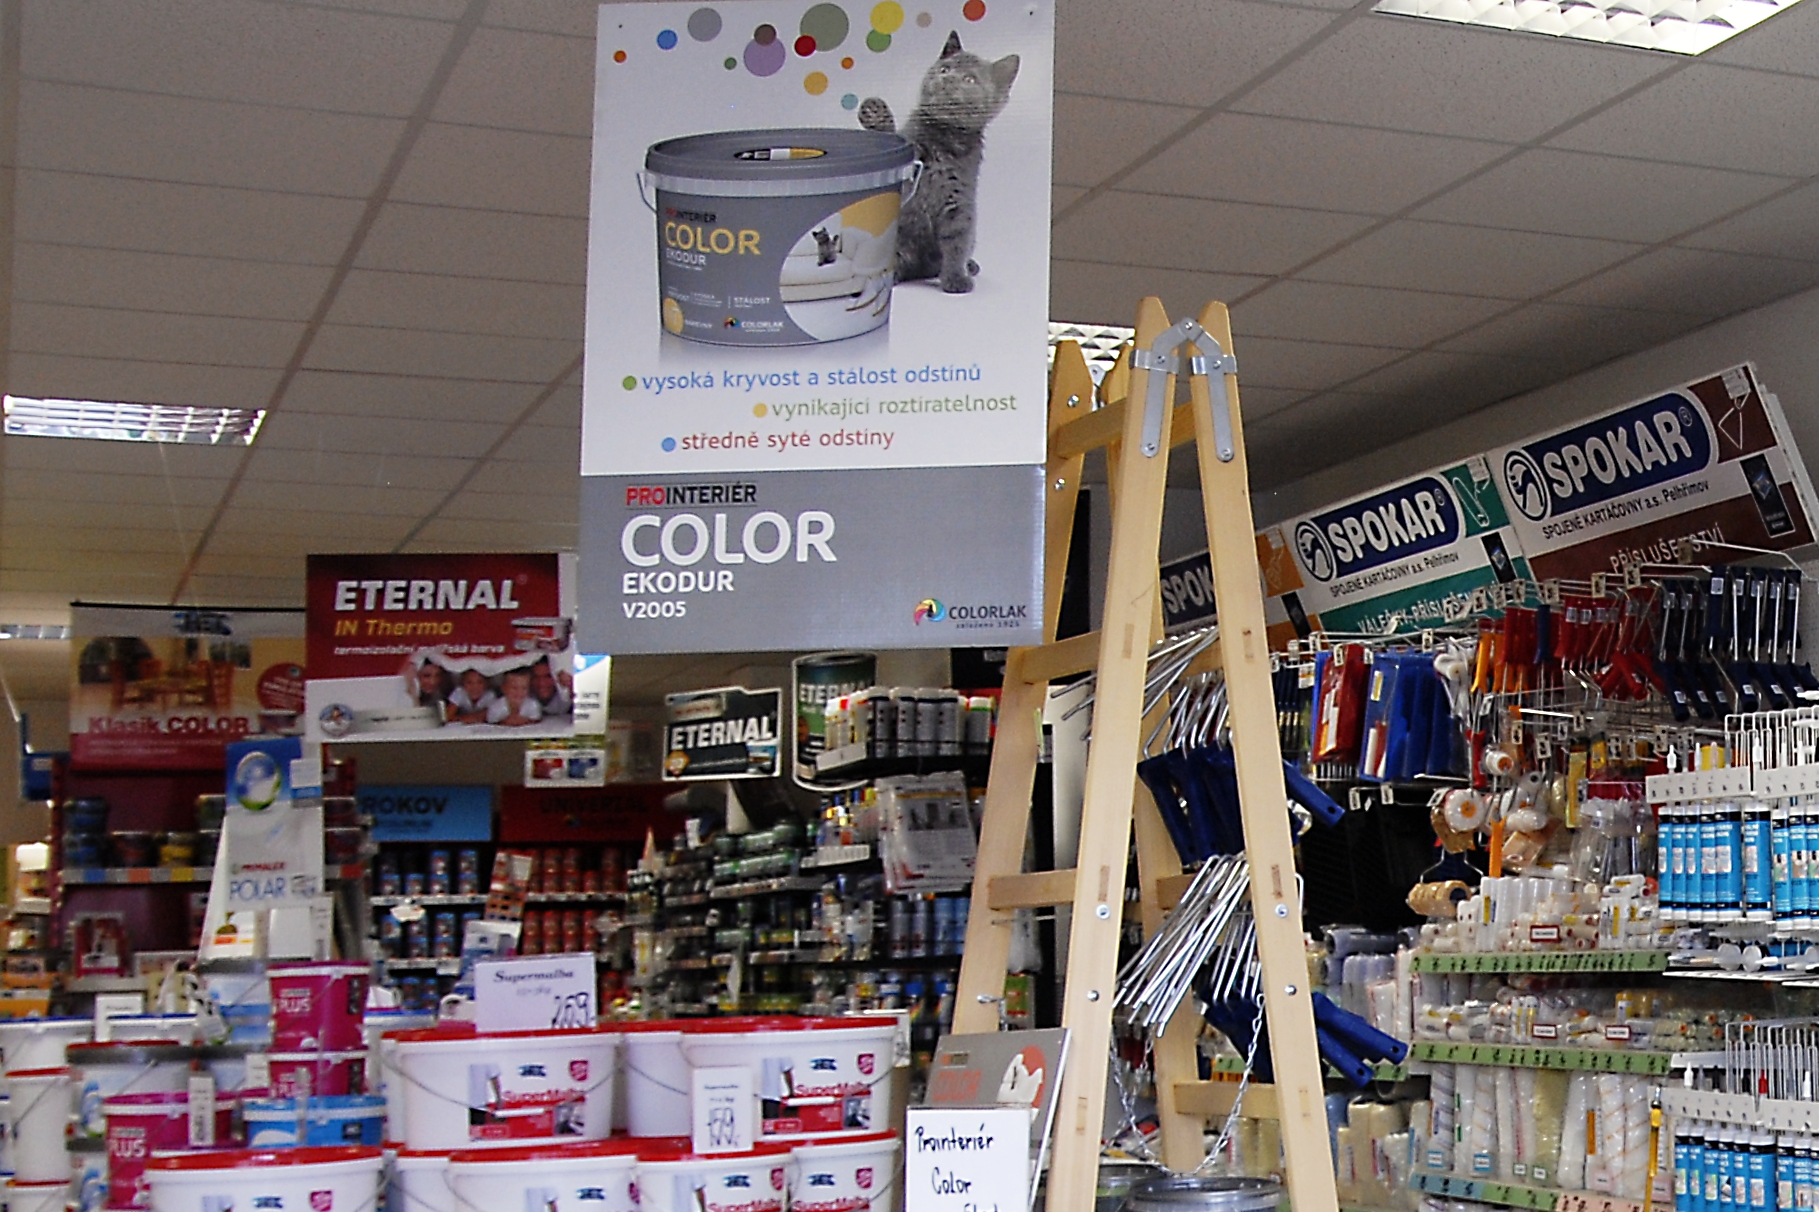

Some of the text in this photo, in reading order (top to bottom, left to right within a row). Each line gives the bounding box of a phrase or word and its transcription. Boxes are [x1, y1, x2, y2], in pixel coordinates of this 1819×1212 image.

[665, 221, 761, 255] COLOR
[642, 363, 981, 393] vysoká kryvost a stálost odstínů
[772, 395, 1017, 417] vynikající roztíratelnost
[681, 429, 894, 451] středně syté odstíny
[1543, 410, 1692, 498] SPOKAR
[626, 484, 757, 505] PROINTERIÉR
[1542, 516, 1584, 540] SPOJENÉ
[1584, 498, 1643, 528] KARTÁČOVNY
[1662, 480, 1709, 503] Pelhřimov
[621, 511, 837, 567] COLOR
[1327, 491, 1446, 563] SPOKAR
[1610, 522, 1726, 573] PŘÍSLUŠESTVÍ
[334, 579, 520, 611] ETERNAL
[622, 571, 734, 595] EKODUR
[623, 602, 686, 618] V2005
[949, 604, 1026, 620] COLORLAK
[335, 617, 453, 637] IN Thermo
[166, 716, 249, 735] COLOR
[671, 717, 774, 750] ETERNAL
[229, 877, 286, 901] POLAR
[931, 1166, 972, 1196] Color
